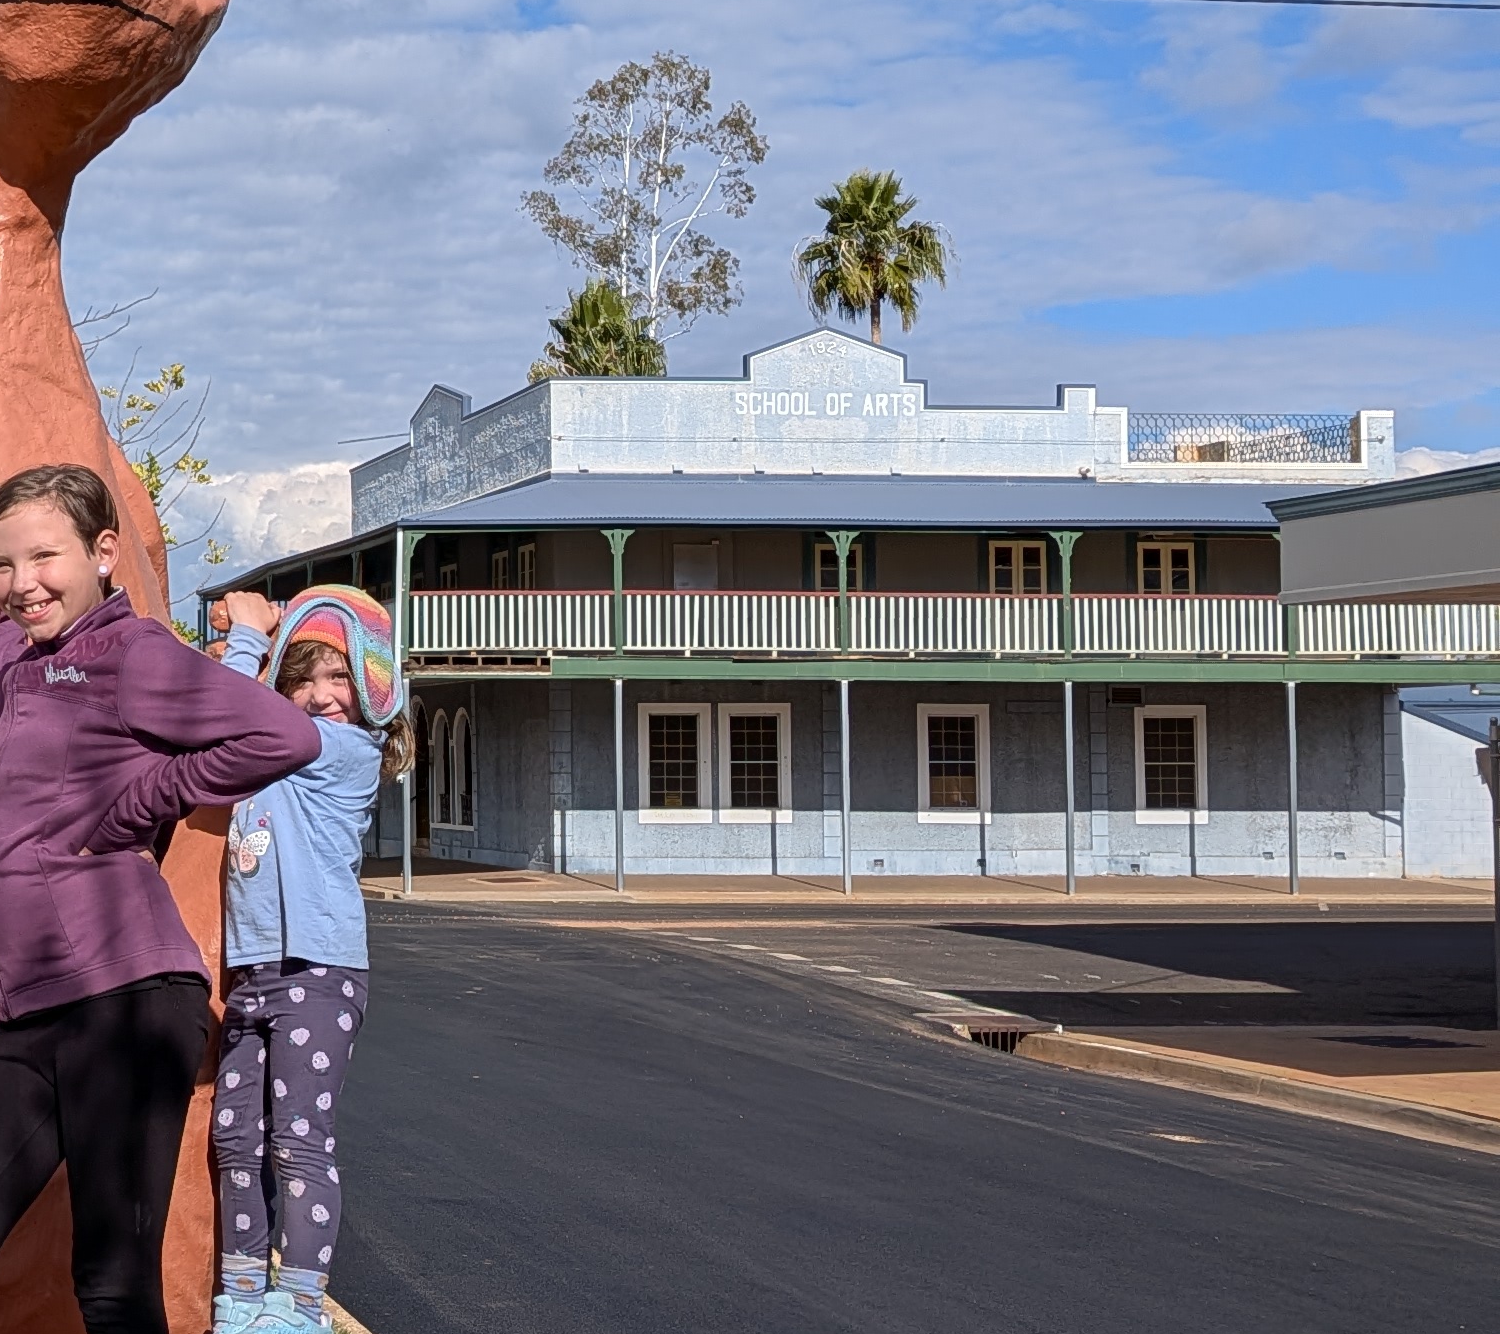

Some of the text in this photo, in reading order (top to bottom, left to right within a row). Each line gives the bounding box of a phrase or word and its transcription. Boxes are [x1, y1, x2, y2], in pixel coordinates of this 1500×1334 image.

[808, 341, 847, 357] 1924
[735, 392, 916, 417] SCHOOL OF ARTS
